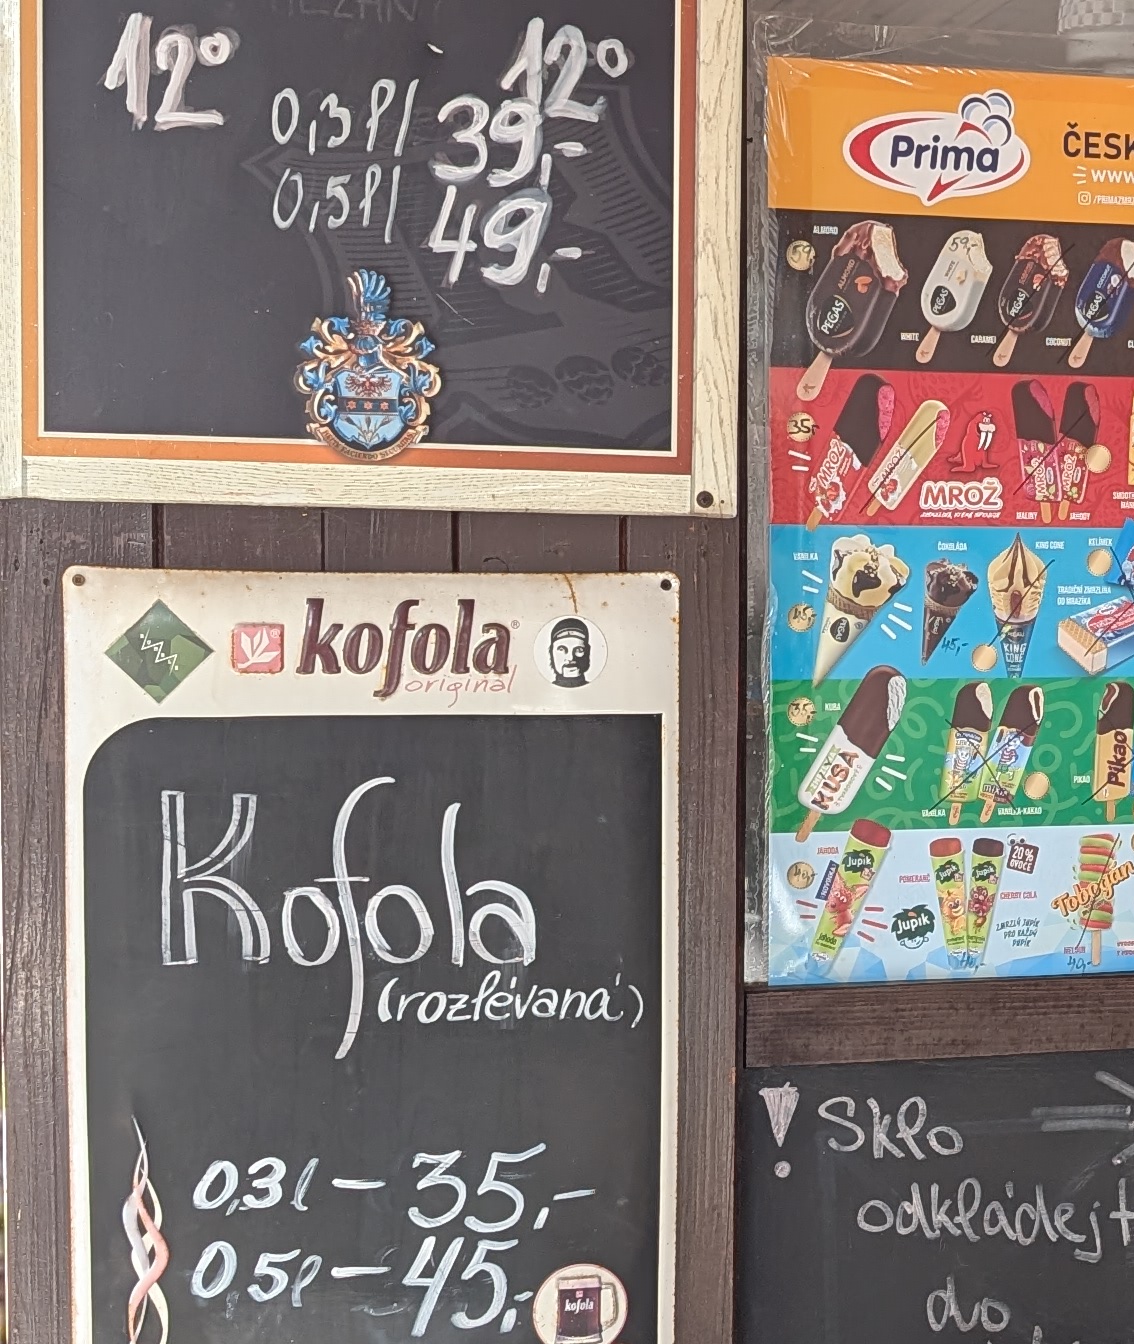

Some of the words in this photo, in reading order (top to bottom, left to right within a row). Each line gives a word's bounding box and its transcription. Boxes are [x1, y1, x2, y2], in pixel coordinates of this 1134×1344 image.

[889, 134, 1001, 174] Prima
[820, 299, 845, 336] PEGAS
[931, 287, 950, 316] PEGAS
[816, 438, 847, 488] MROŽ
[921, 478, 1000, 508] MROŽ
[296, 598, 513, 698] kofola
[405, 665, 518, 708] original
[1107, 730, 1128, 787] Pikao
[1009, 858, 1032, 872] OVOCE
[160, 776, 537, 1060] Kofola
[378, 971, 645, 1029] (rozlévaná)
[817, 1095, 964, 1160] Sklo
[564, 1297, 595, 1315] kofola
[926, 1275, 1011, 1332] do
